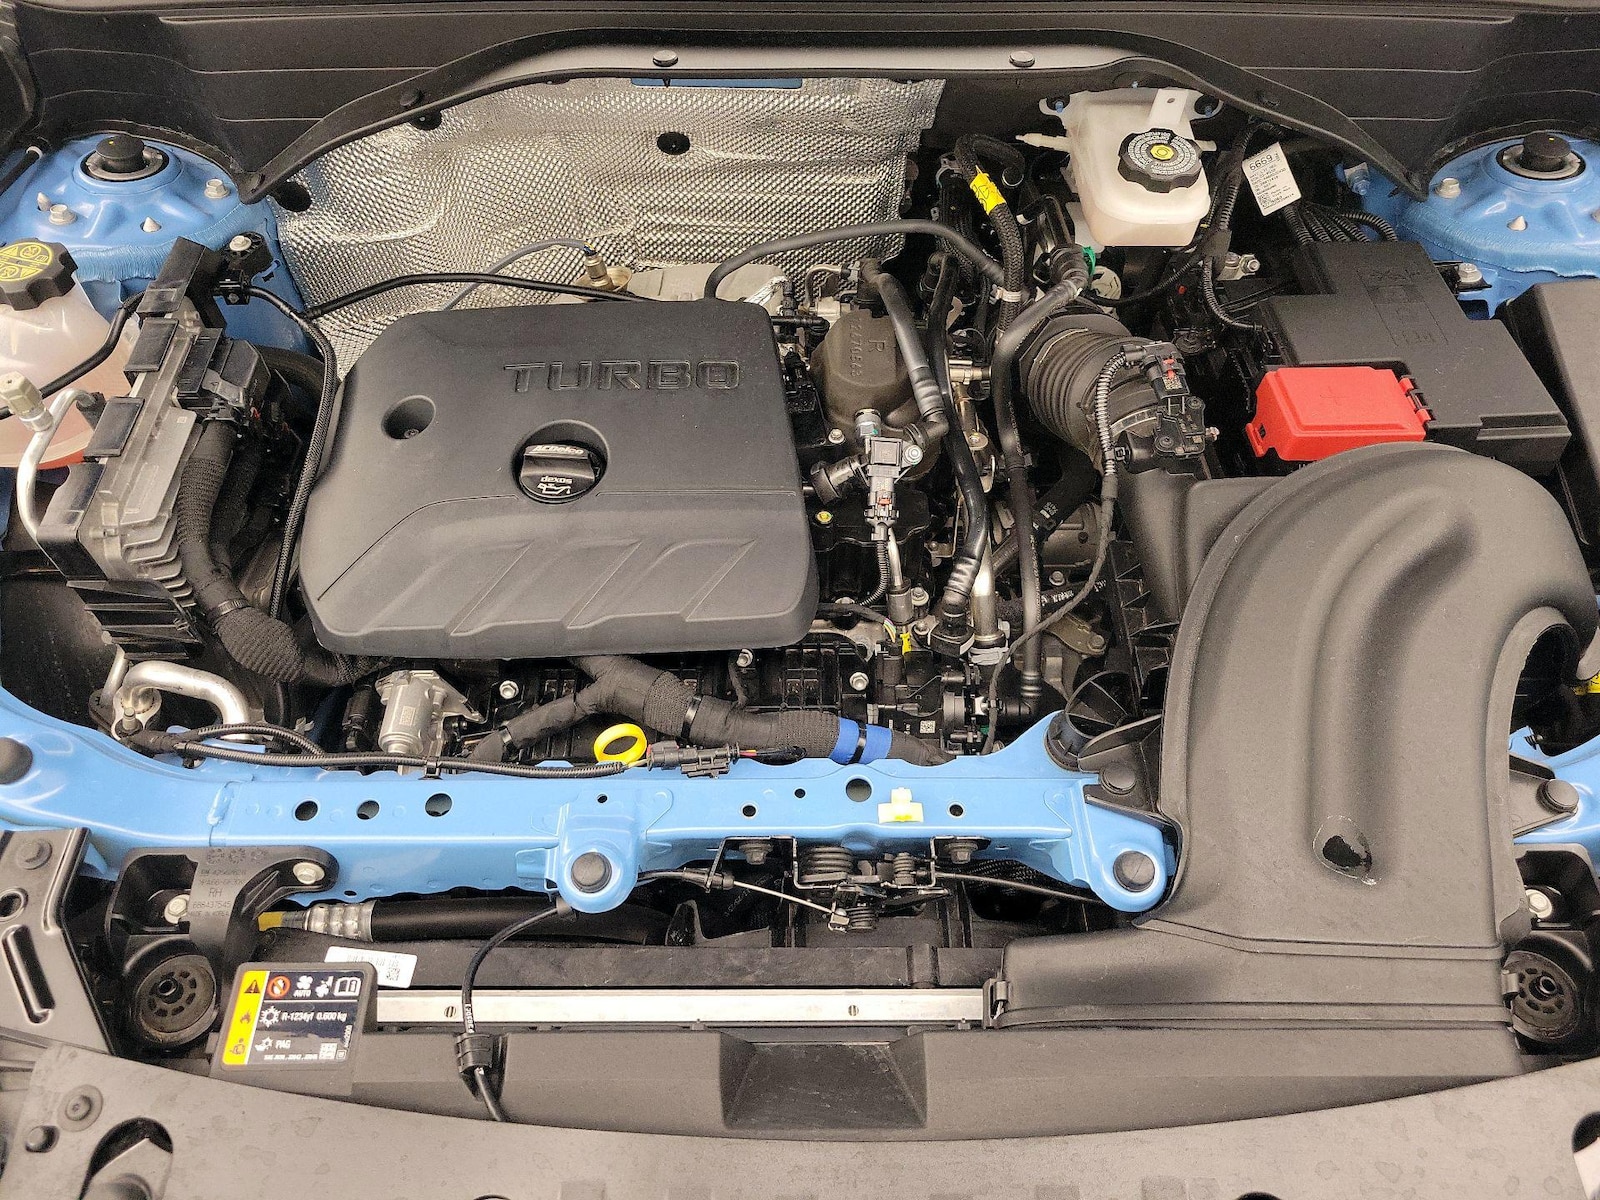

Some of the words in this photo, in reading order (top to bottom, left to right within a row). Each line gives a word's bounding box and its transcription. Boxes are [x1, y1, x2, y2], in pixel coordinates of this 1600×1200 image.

[1249, 154, 1273, 171] 6669
[503, 360, 740, 392] TURBO
[532, 444, 584, 455] ACDelco
[540, 475, 573, 485] dexos
[293, 989, 312, 997] AUTO
[316, 1011, 337, 1021] 0.600
[337, 1012, 347, 1023] kg
[275, 1039, 291, 1049] PAG
